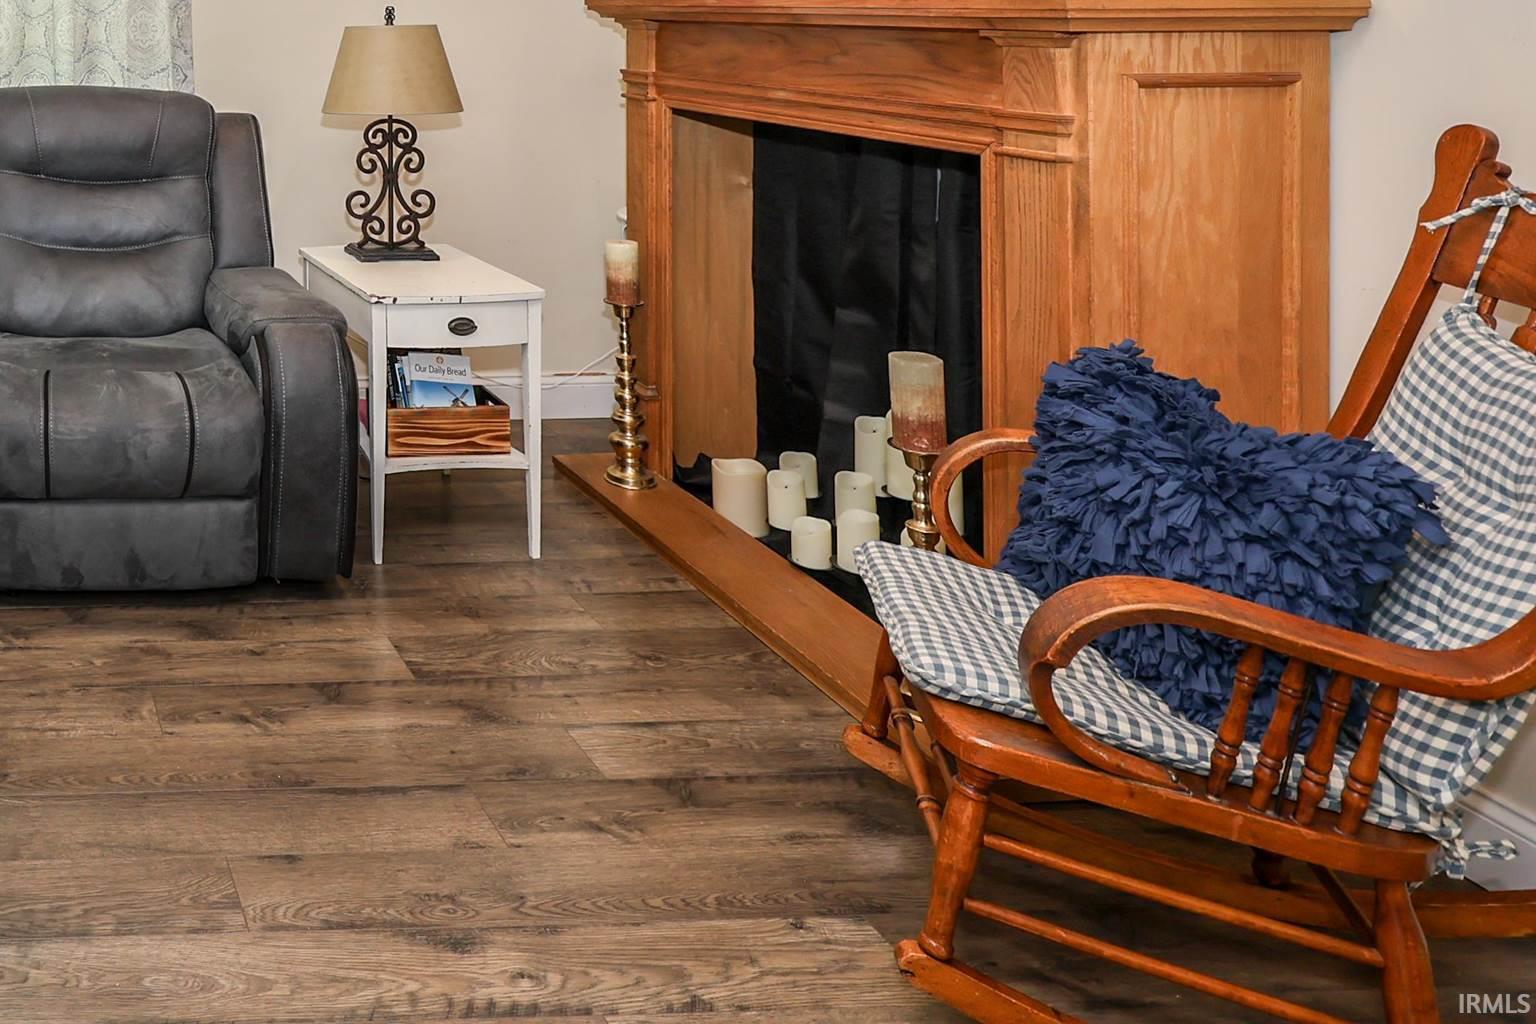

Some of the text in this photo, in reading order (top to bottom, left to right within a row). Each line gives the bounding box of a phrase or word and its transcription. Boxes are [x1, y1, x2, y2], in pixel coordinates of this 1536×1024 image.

[415, 363, 467, 376] Our Daily Bread
